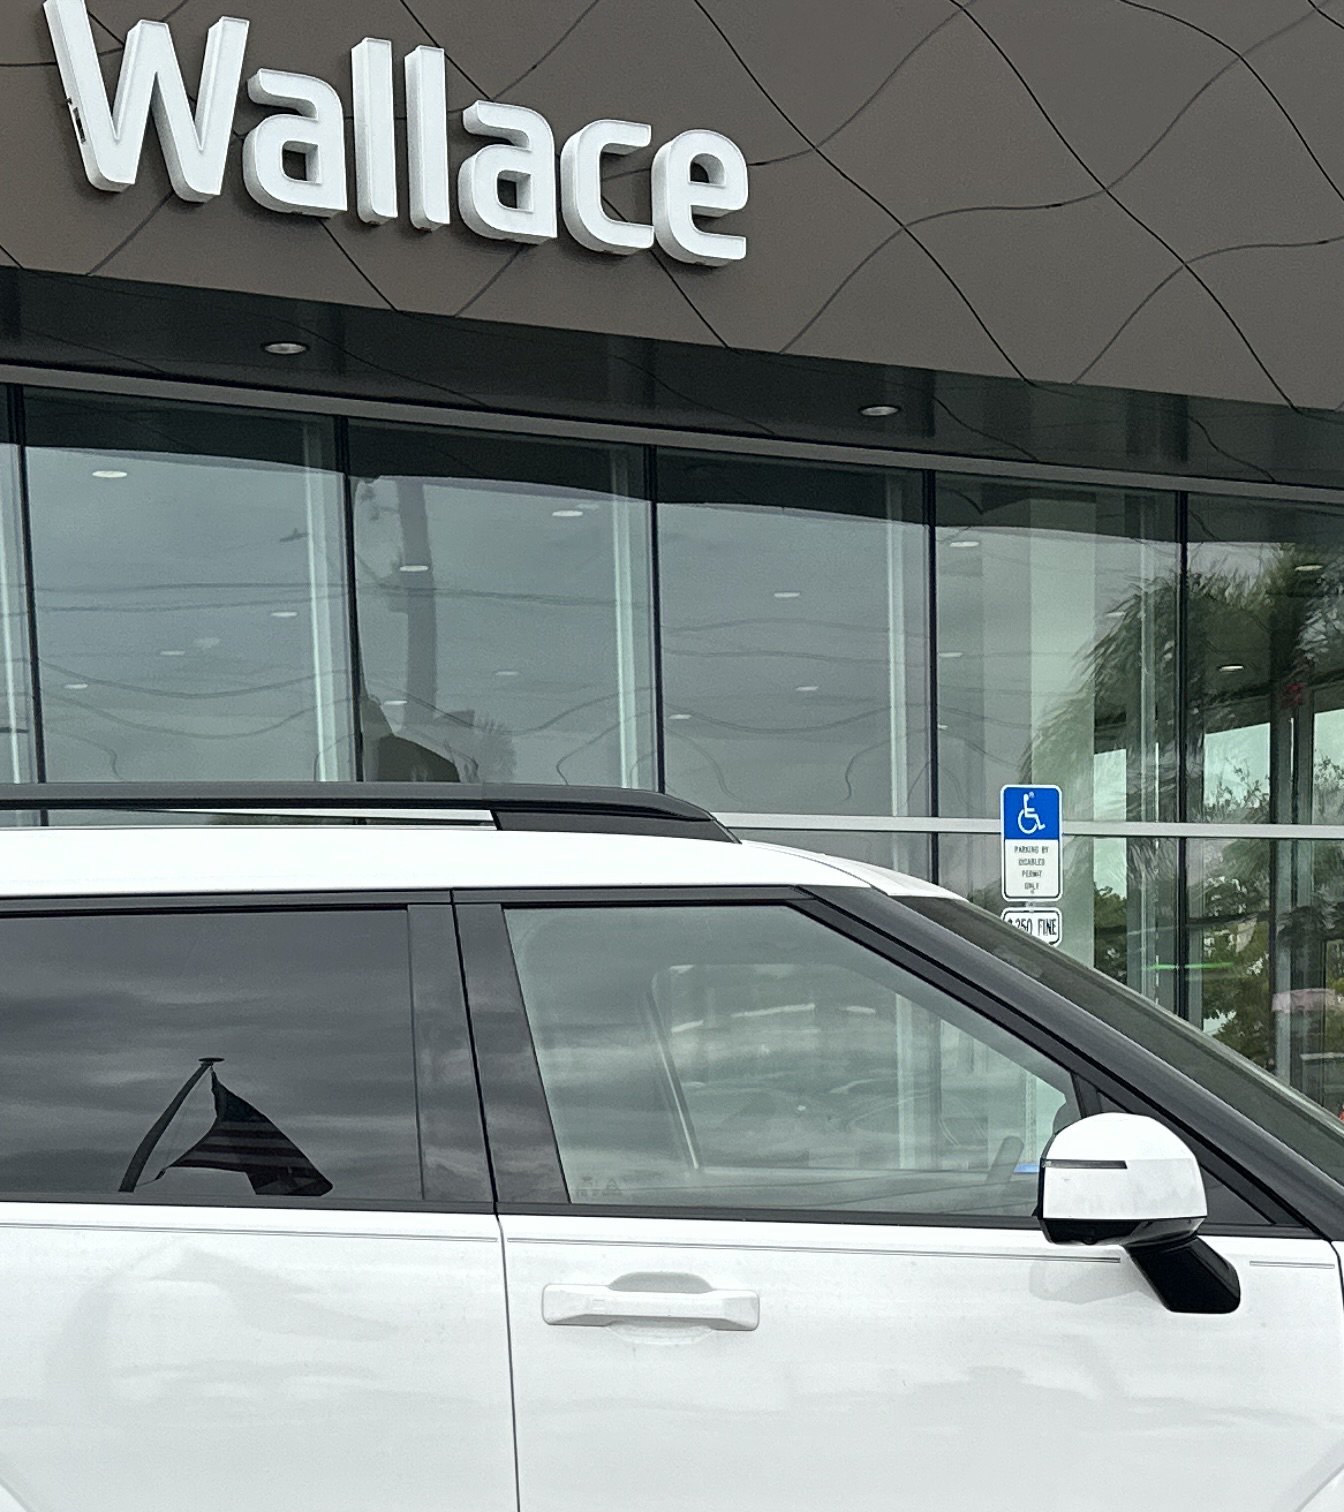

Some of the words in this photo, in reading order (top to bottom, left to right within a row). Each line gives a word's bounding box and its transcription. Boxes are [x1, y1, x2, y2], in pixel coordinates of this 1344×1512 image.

[43, 0, 749, 267] Wallace
[1014, 845, 1039, 854] PARKING
[1042, 845, 1049, 854] BY
[1018, 858, 1045, 866] DISABLED
[1022, 869, 1042, 877] PERMIT
[1038, 918, 1057, 936] FINE
